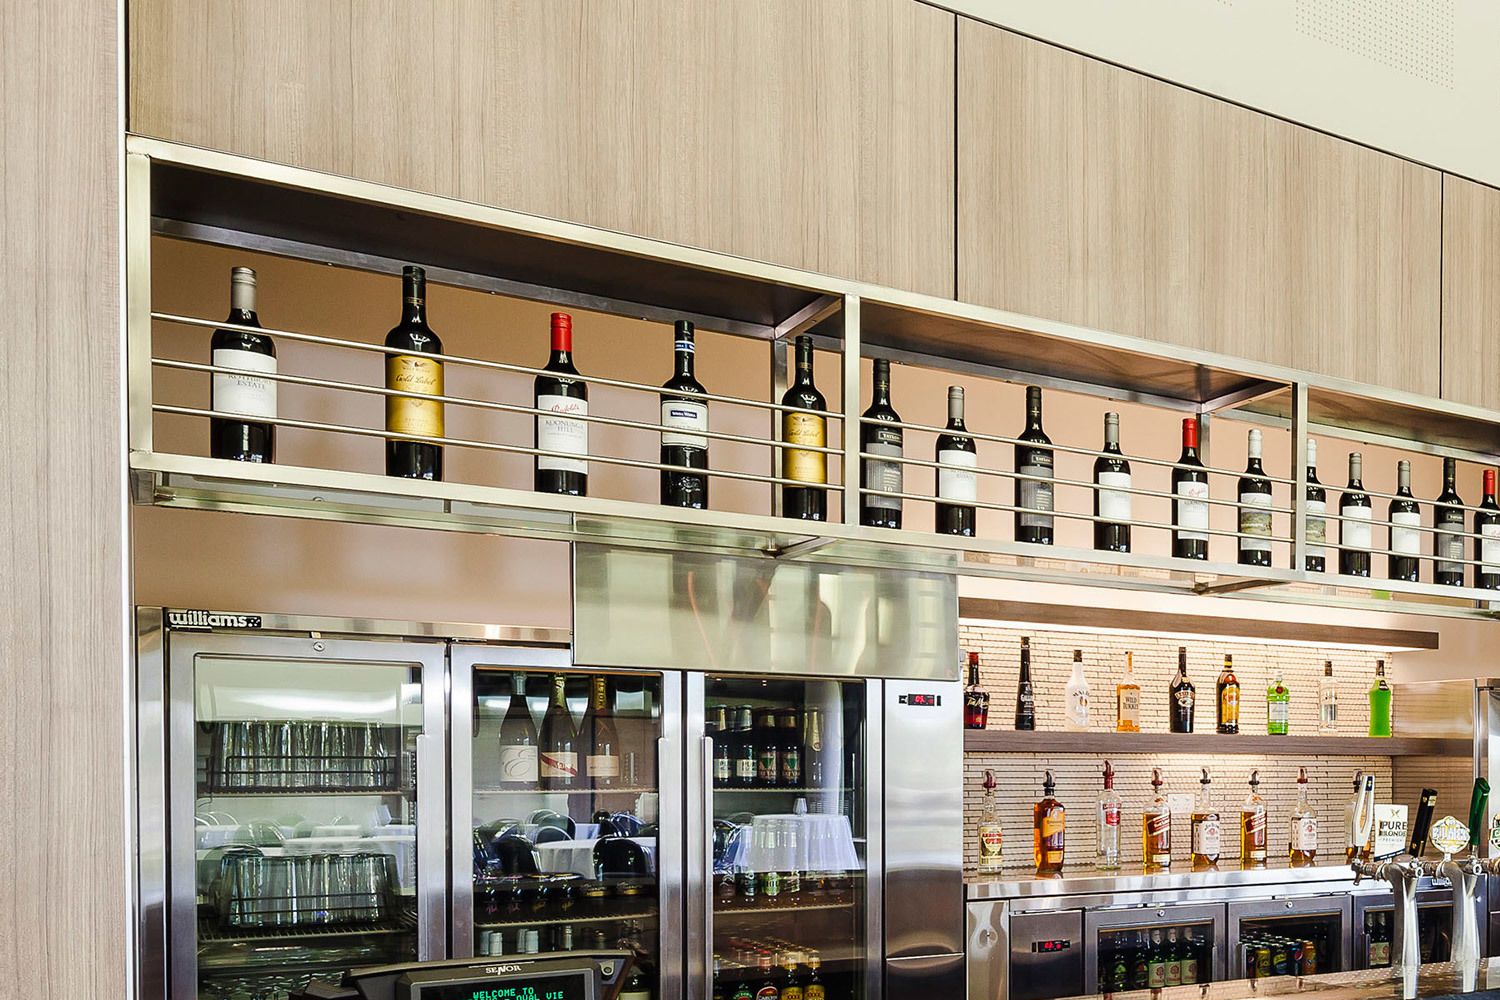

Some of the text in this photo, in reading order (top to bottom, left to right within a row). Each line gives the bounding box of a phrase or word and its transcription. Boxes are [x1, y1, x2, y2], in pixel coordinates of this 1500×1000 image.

[169, 611, 247, 628] williams
[1380, 821, 1408, 830] PURE
[473, 986, 534, 1000] WELCOME TO
[546, 991, 564, 1000] VIE
